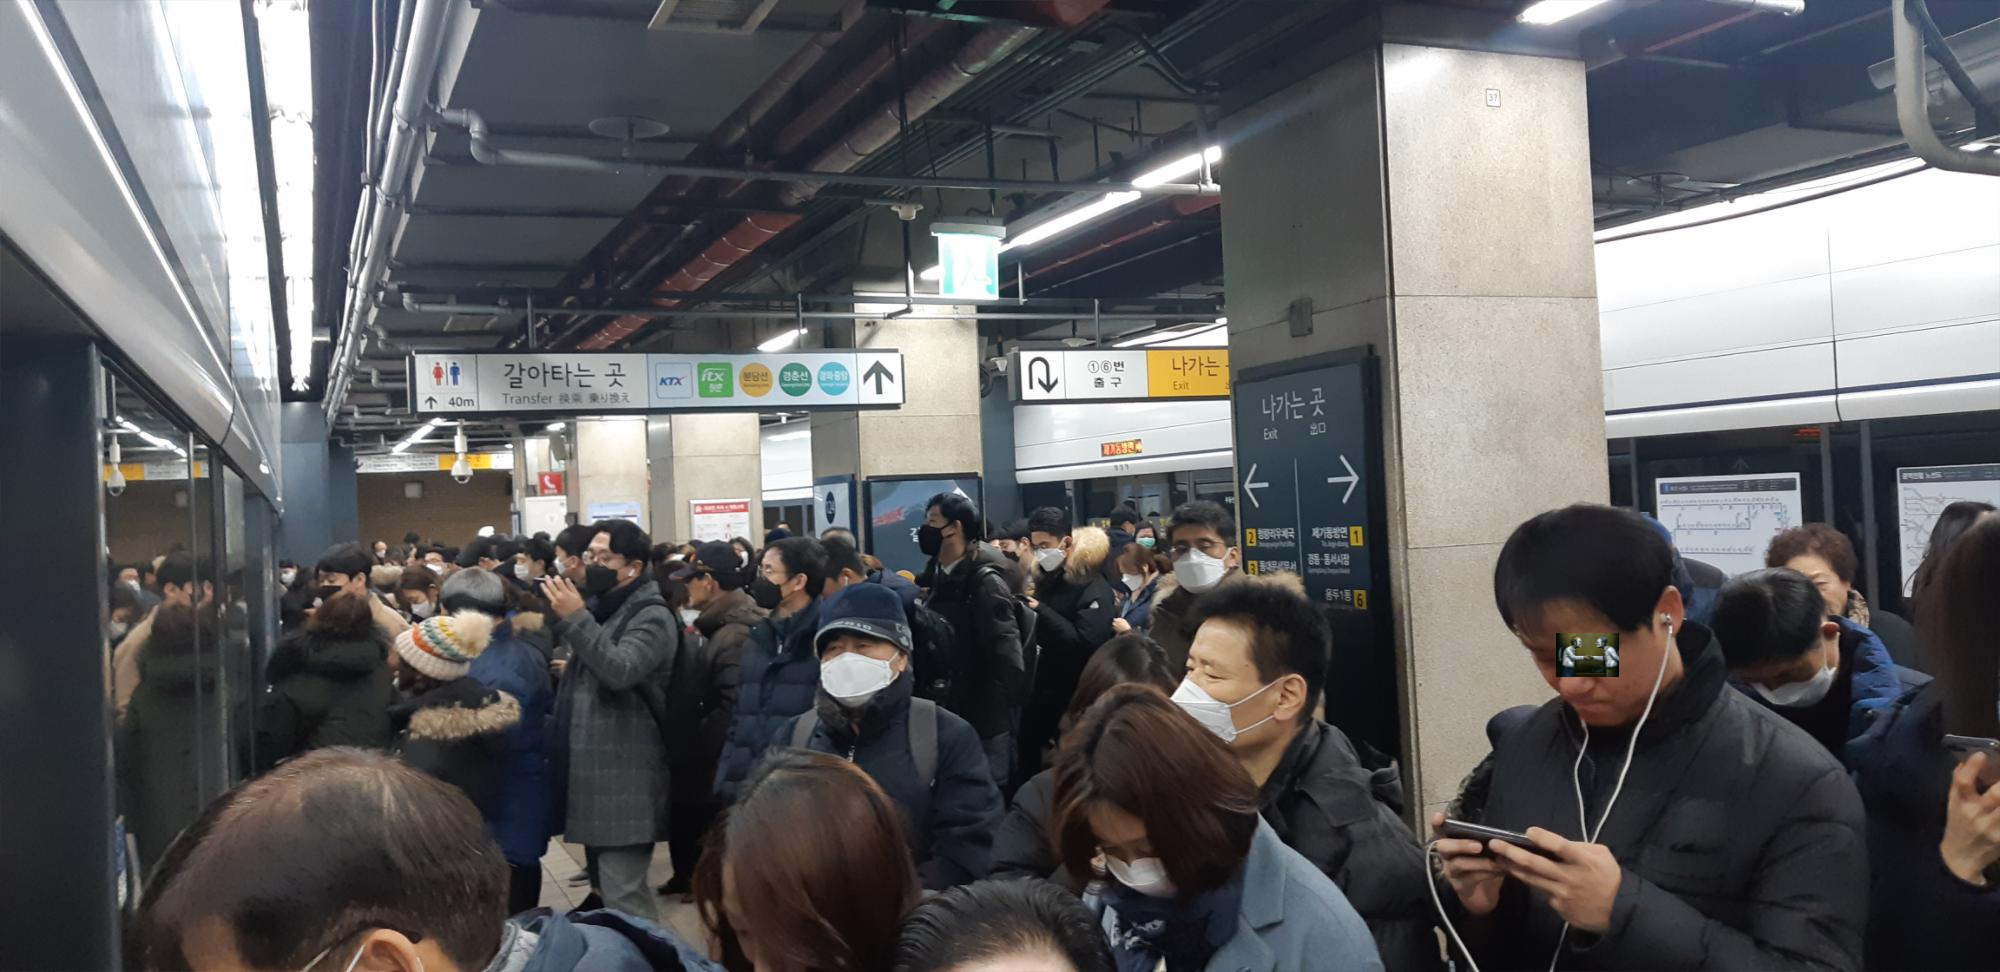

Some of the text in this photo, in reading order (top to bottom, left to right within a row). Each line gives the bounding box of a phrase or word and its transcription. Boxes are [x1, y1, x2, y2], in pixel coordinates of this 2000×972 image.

[1171, 355, 1220, 376] 나가는
[503, 362, 626, 389] 갈아타는 곳
[659, 375, 687, 386] KTX
[743, 371, 768, 382] 분당선
[782, 370, 809, 381] 경춘선
[1173, 380, 1190, 390] Exit
[448, 397, 475, 407] 40m
[502, 392, 553, 405] Transfer
[1262, 387, 1326, 422] 나가는 곳
[1263, 428, 1278, 440] Exit
[1309, 422, 1327, 436] 出口
[1248, 531, 1254, 544] 2
[1311, 526, 1348, 539] 제기동방면
[1352, 530, 1359, 544] 1
[1356, 592, 1363, 607] 6
